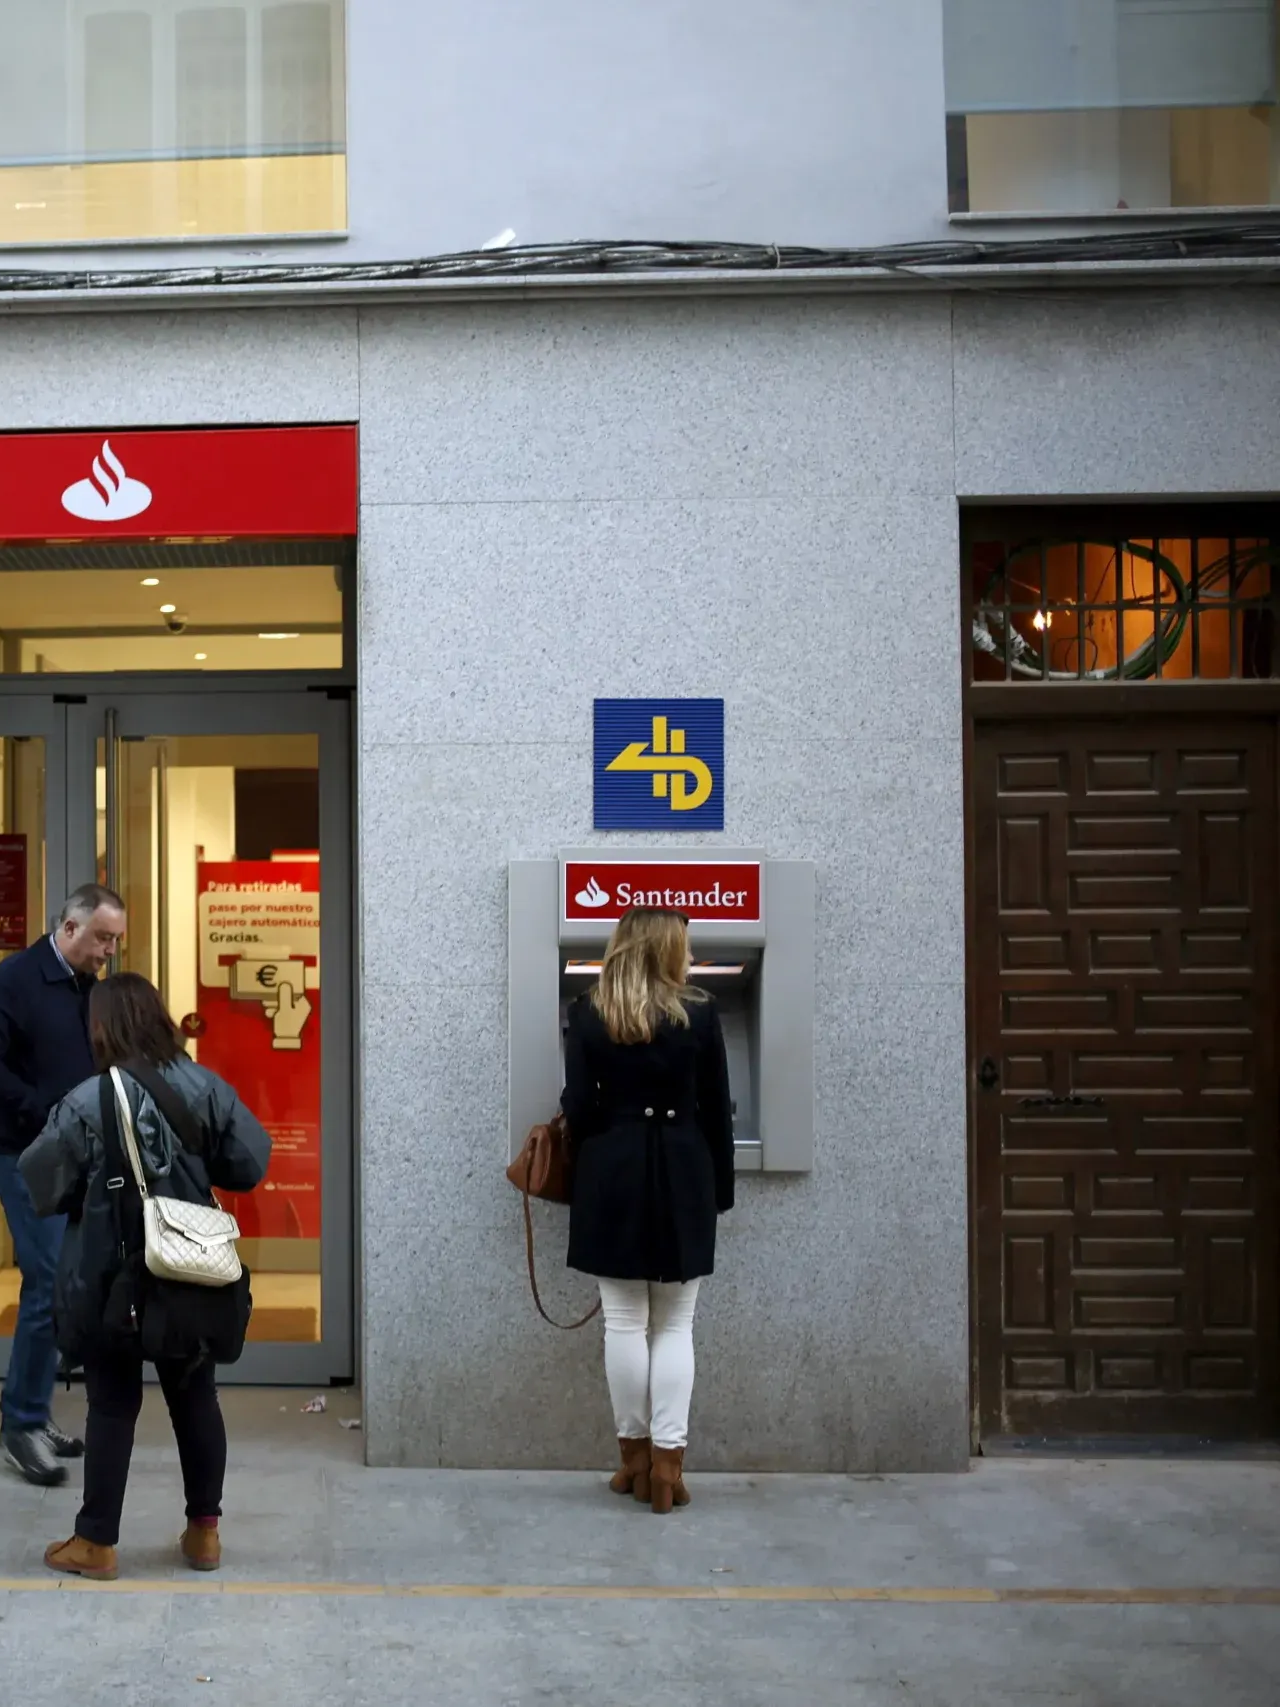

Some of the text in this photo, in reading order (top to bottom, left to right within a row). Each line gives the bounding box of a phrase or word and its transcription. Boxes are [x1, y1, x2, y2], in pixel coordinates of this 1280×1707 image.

[208, 880, 302, 893] Para retiradas
[616, 881, 747, 907] Santander
[208, 903, 313, 914] pase por nuestro
[209, 918, 320, 929] cajero automático
